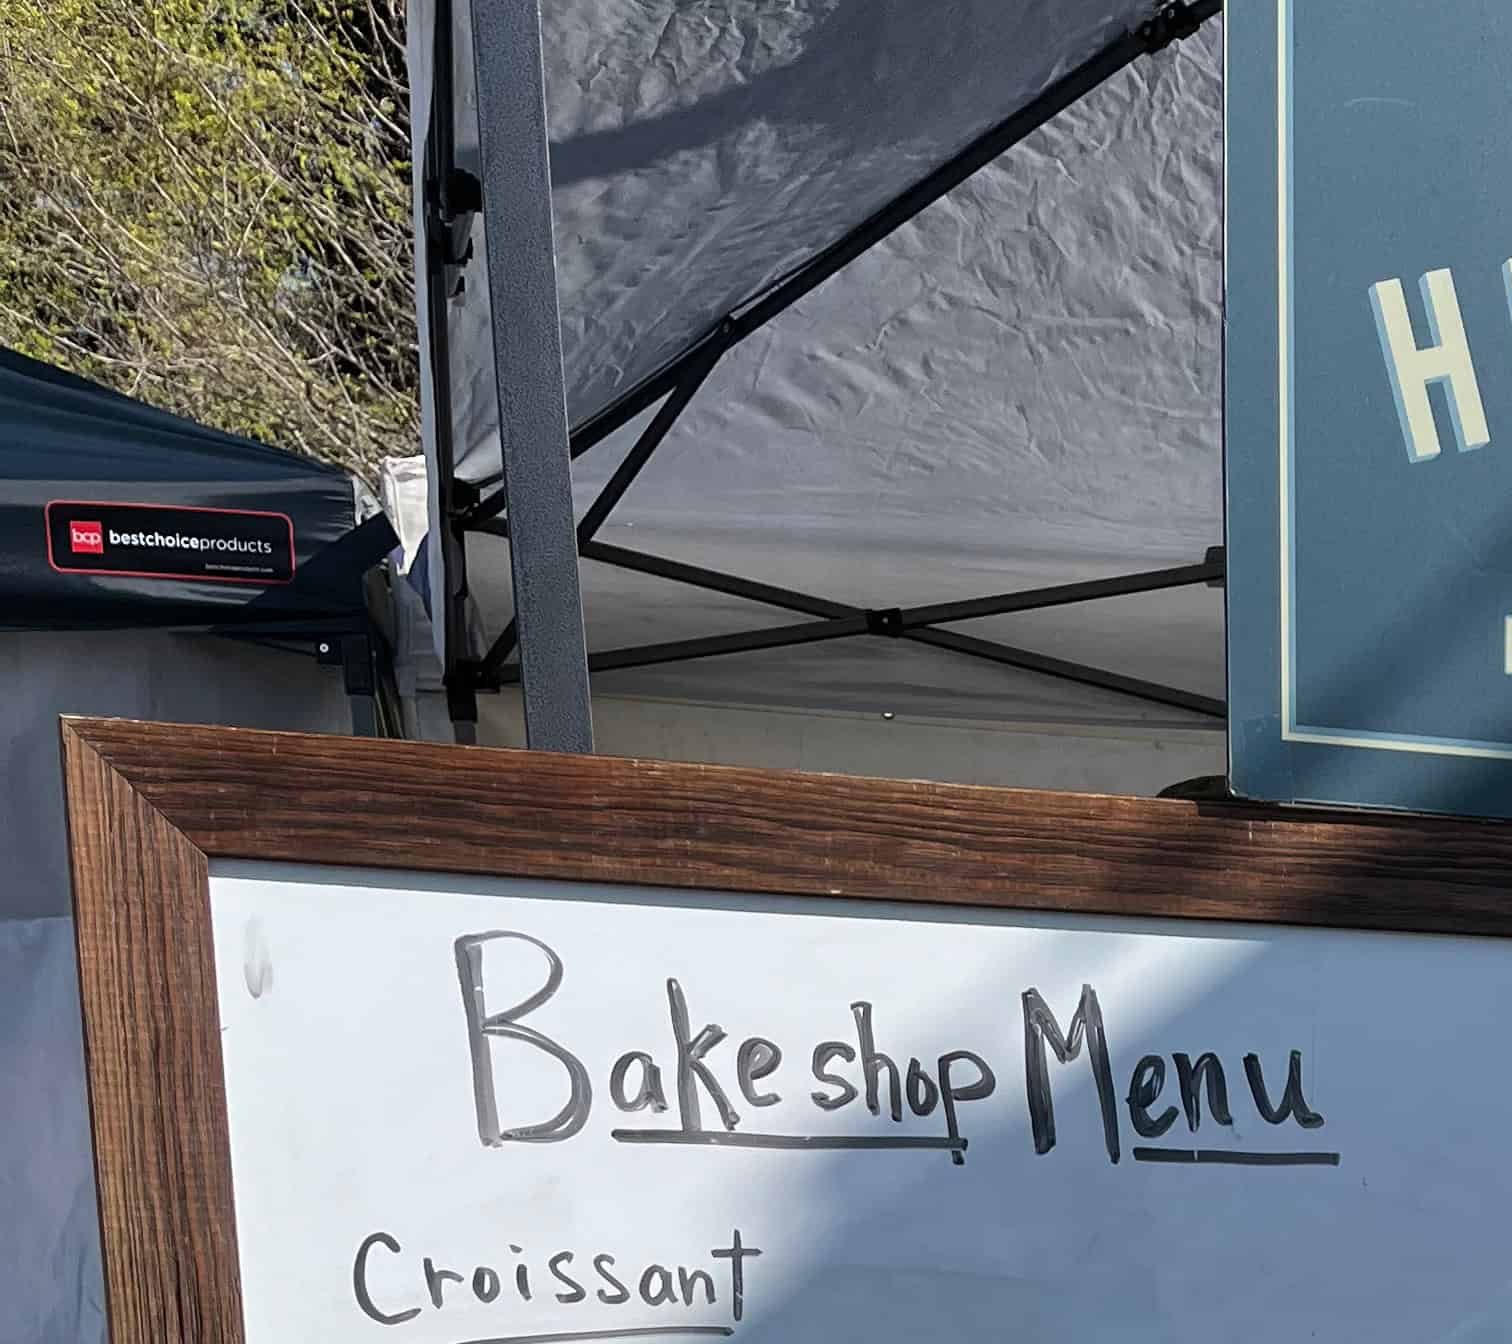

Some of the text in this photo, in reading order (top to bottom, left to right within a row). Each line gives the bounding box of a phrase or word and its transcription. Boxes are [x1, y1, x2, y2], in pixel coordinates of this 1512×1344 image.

[72, 528, 272, 553] bcp bestchoiceproducts
[455, 930, 1324, 1165] Bakeshop Menu
[354, 1229, 762, 1325] Croissant
